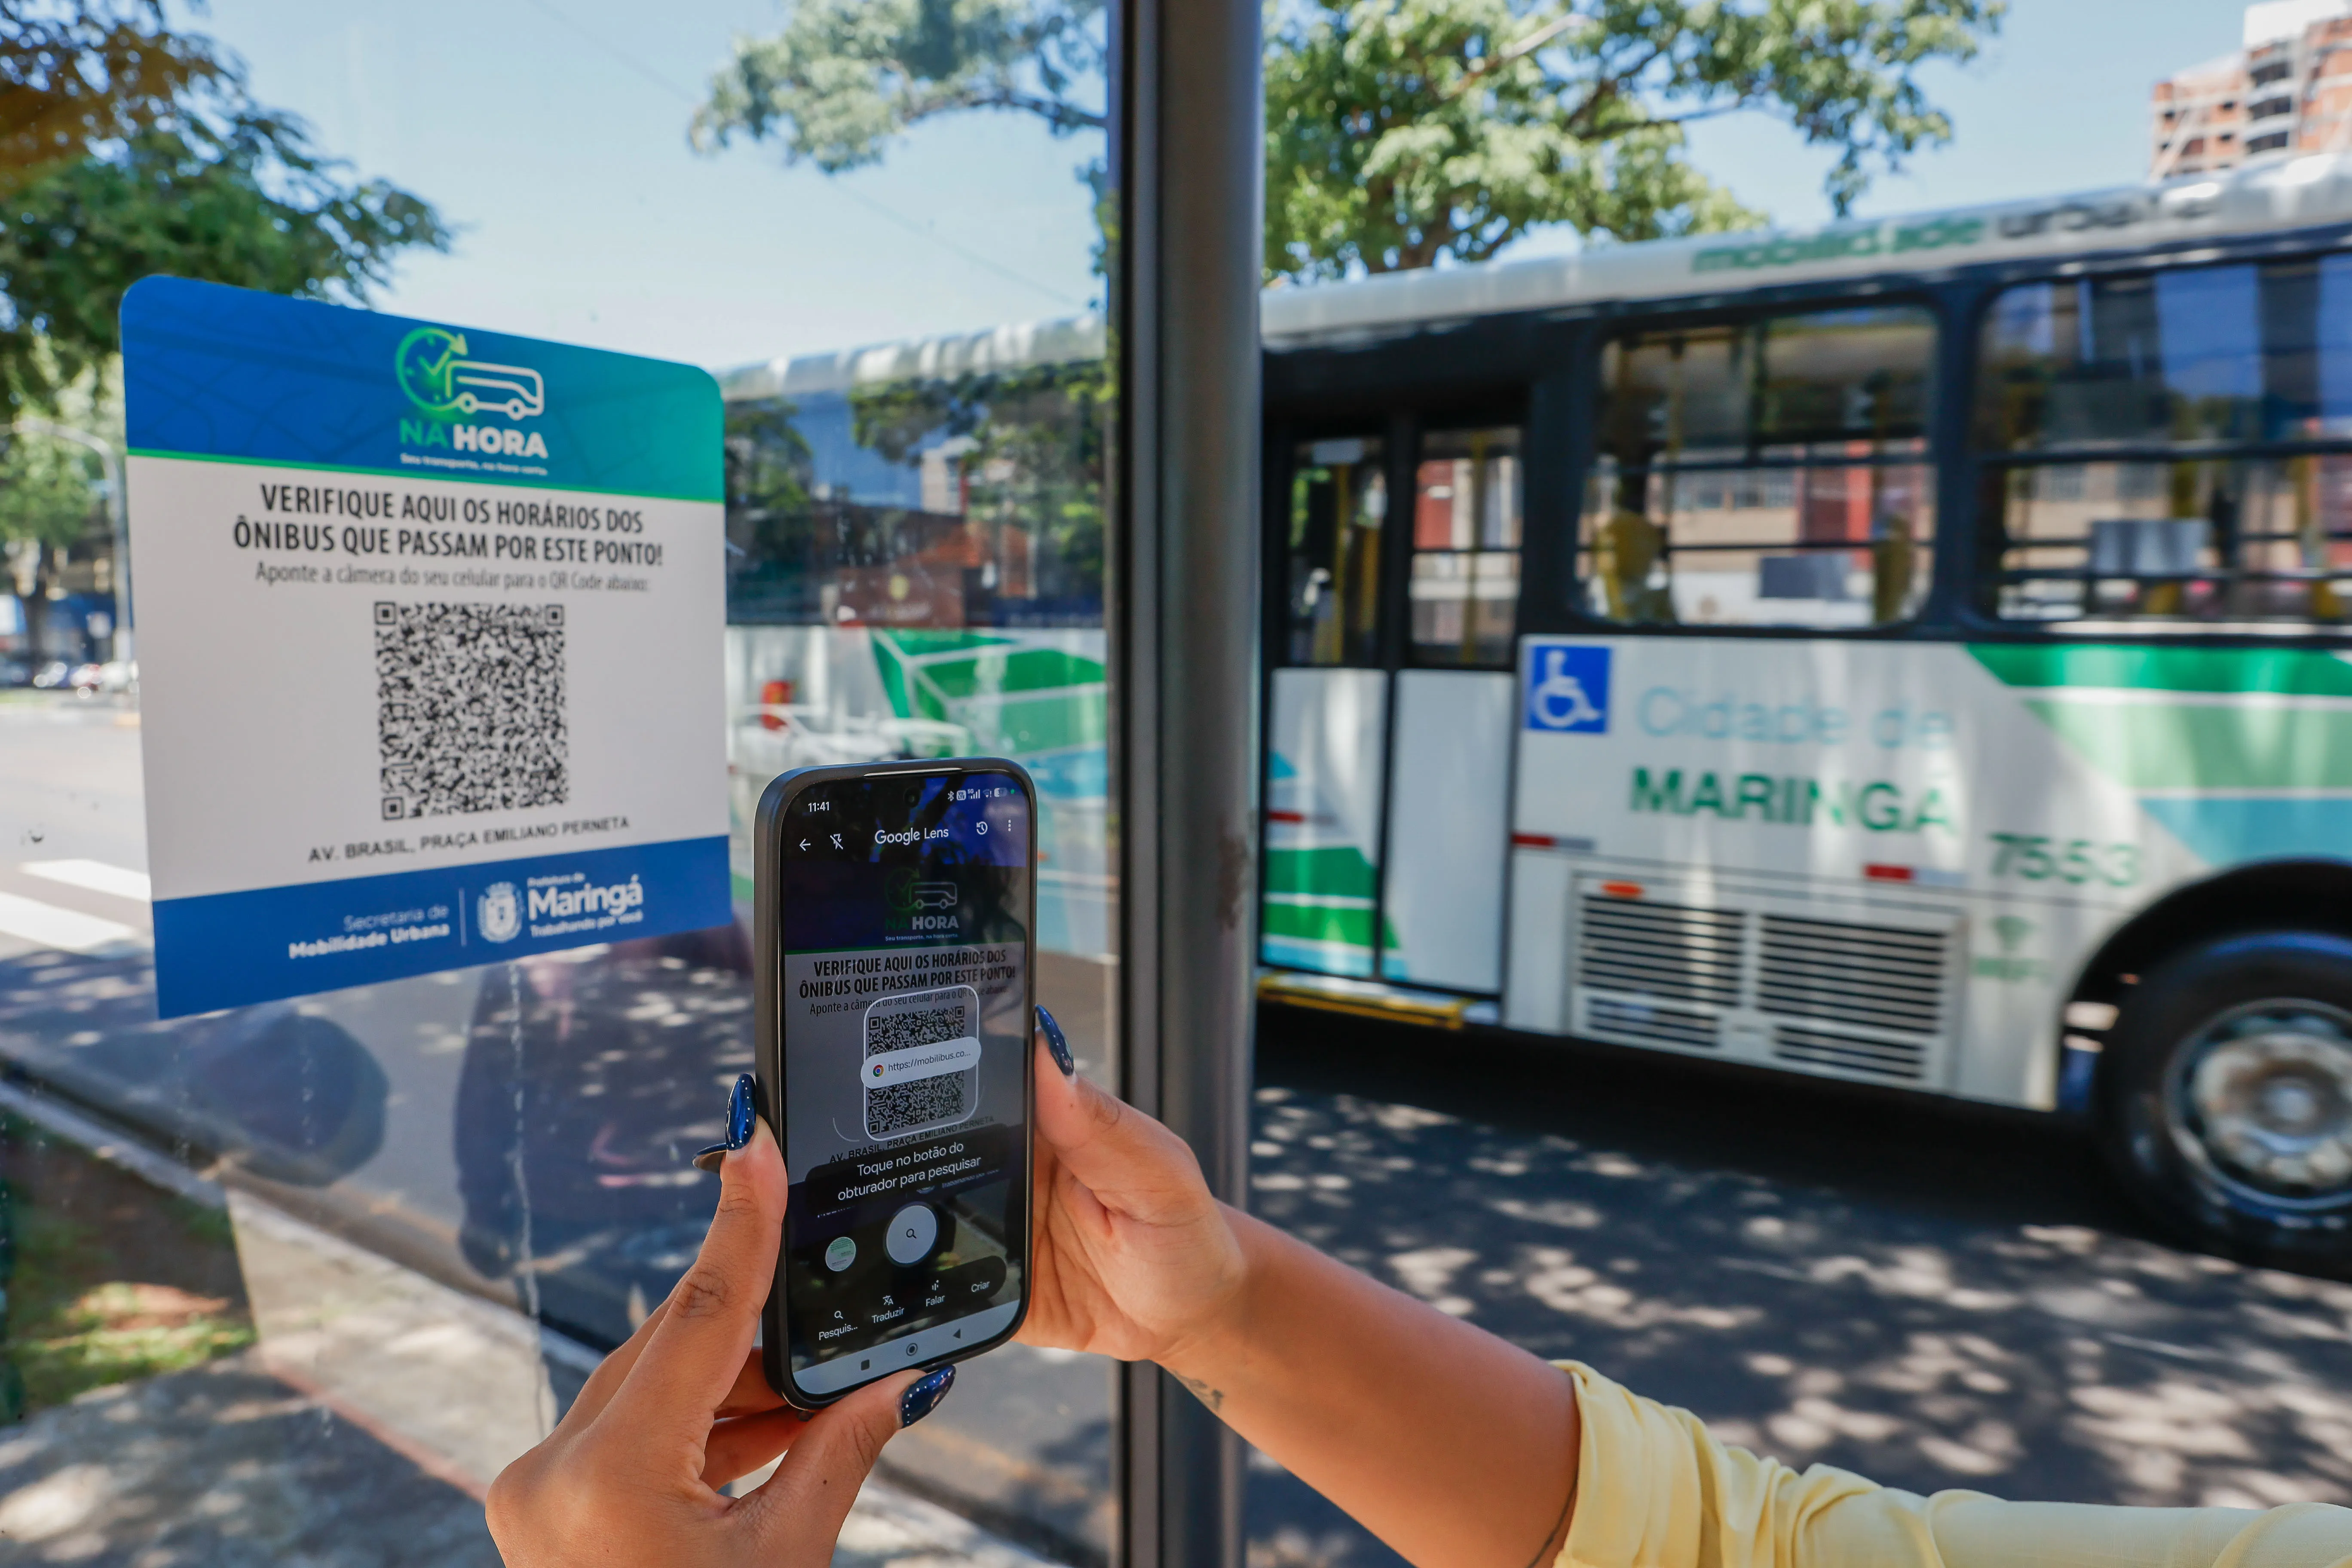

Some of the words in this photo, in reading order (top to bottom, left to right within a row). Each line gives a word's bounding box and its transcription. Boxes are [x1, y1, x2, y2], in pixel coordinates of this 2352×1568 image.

[399, 419, 449, 449] NA
[453, 423, 549, 459] HORA
[261, 483, 394, 519] VERIFIQUE
[402, 495, 456, 523] AQUI
[464, 498, 490, 524] OS
[497, 499, 601, 530] HORÁRIOS
[607, 508, 643, 533] DOS
[234, 514, 334, 551] ÔNIBUS
[344, 527, 389, 556] QUE
[399, 530, 488, 558] PASSAM
[495, 535, 536, 560] POR
[544, 537, 587, 562] ESTE
[594, 540, 663, 566] PONTO!
[255, 560, 318, 588] Aponte
[322, 567, 332, 584] a
[336, 563, 395, 585] câmera
[399, 565, 420, 585] do
[424, 569, 449, 586] seu
[452, 568, 500, 588] celular
[503, 572, 534, 594] para
[538, 574, 546, 589] o
[549, 570, 569, 590] QR
[571, 571, 601, 591] Code
[1637, 686, 1850, 746] Cidade
[1872, 693, 1954, 750] de
[808, 802, 829, 812] 11:41
[308, 845, 340, 863] AV.
[345, 839, 416, 859] BRASIL,
[420, 831, 478, 849] PRAÇA
[483, 822, 557, 844] EMILIANO
[562, 816, 630, 835] PERNETA
[874, 827, 920, 845] Google
[924, 827, 949, 839] Lens
[1987, 830, 2141, 888] 7553
[528, 873, 643, 921] Maringá
[344, 908, 425, 932] Secretaria
[427, 904, 449, 920] de
[912, 916, 959, 930] HORA
[288, 931, 388, 959] Mobilidade
[390, 923, 450, 943] Urbana
[813, 958, 881, 977] VERIFIQUE
[884, 956, 913, 972] AQUI
[915, 955, 929, 969] OS
[932, 949, 984, 968] HORÁRIOS
[987, 949, 1006, 963] DOS
[799, 980, 851, 999] ÔNIBUS
[854, 977, 879, 995] QUE
[882, 973, 928, 991] PASSAM
[931, 971, 952, 986] POR
[955, 969, 978, 984] ESTE
[980, 965, 1016, 981] PONTO!
[810, 1003, 842, 1017] Aponte
[844, 1003, 848, 1011] a
[894, 997, 907, 1005] seu
[909, 994, 932, 1004] celular
[935, 992, 950, 1003] para
[888, 1051, 971, 1072] https://mobilibus.co...
[887, 1135, 917, 1149] PRAÇA
[919, 1124, 957, 1141] EMILIANO
[858, 1160, 893, 1176] Toque
[896, 1156, 911, 1167] no
[913, 1145, 946, 1163] botão
[949, 1142, 964, 1154] do
[838, 1178, 898, 1200] obturador
[900, 1171, 925, 1188] para
[928, 1157, 981, 1181] pesquisar
[925, 1295, 945, 1307] Falar
[971, 1280, 990, 1292] Criar
[871, 1307, 904, 1323] Traduzir
[819, 1323, 858, 1340] Pesquis...
